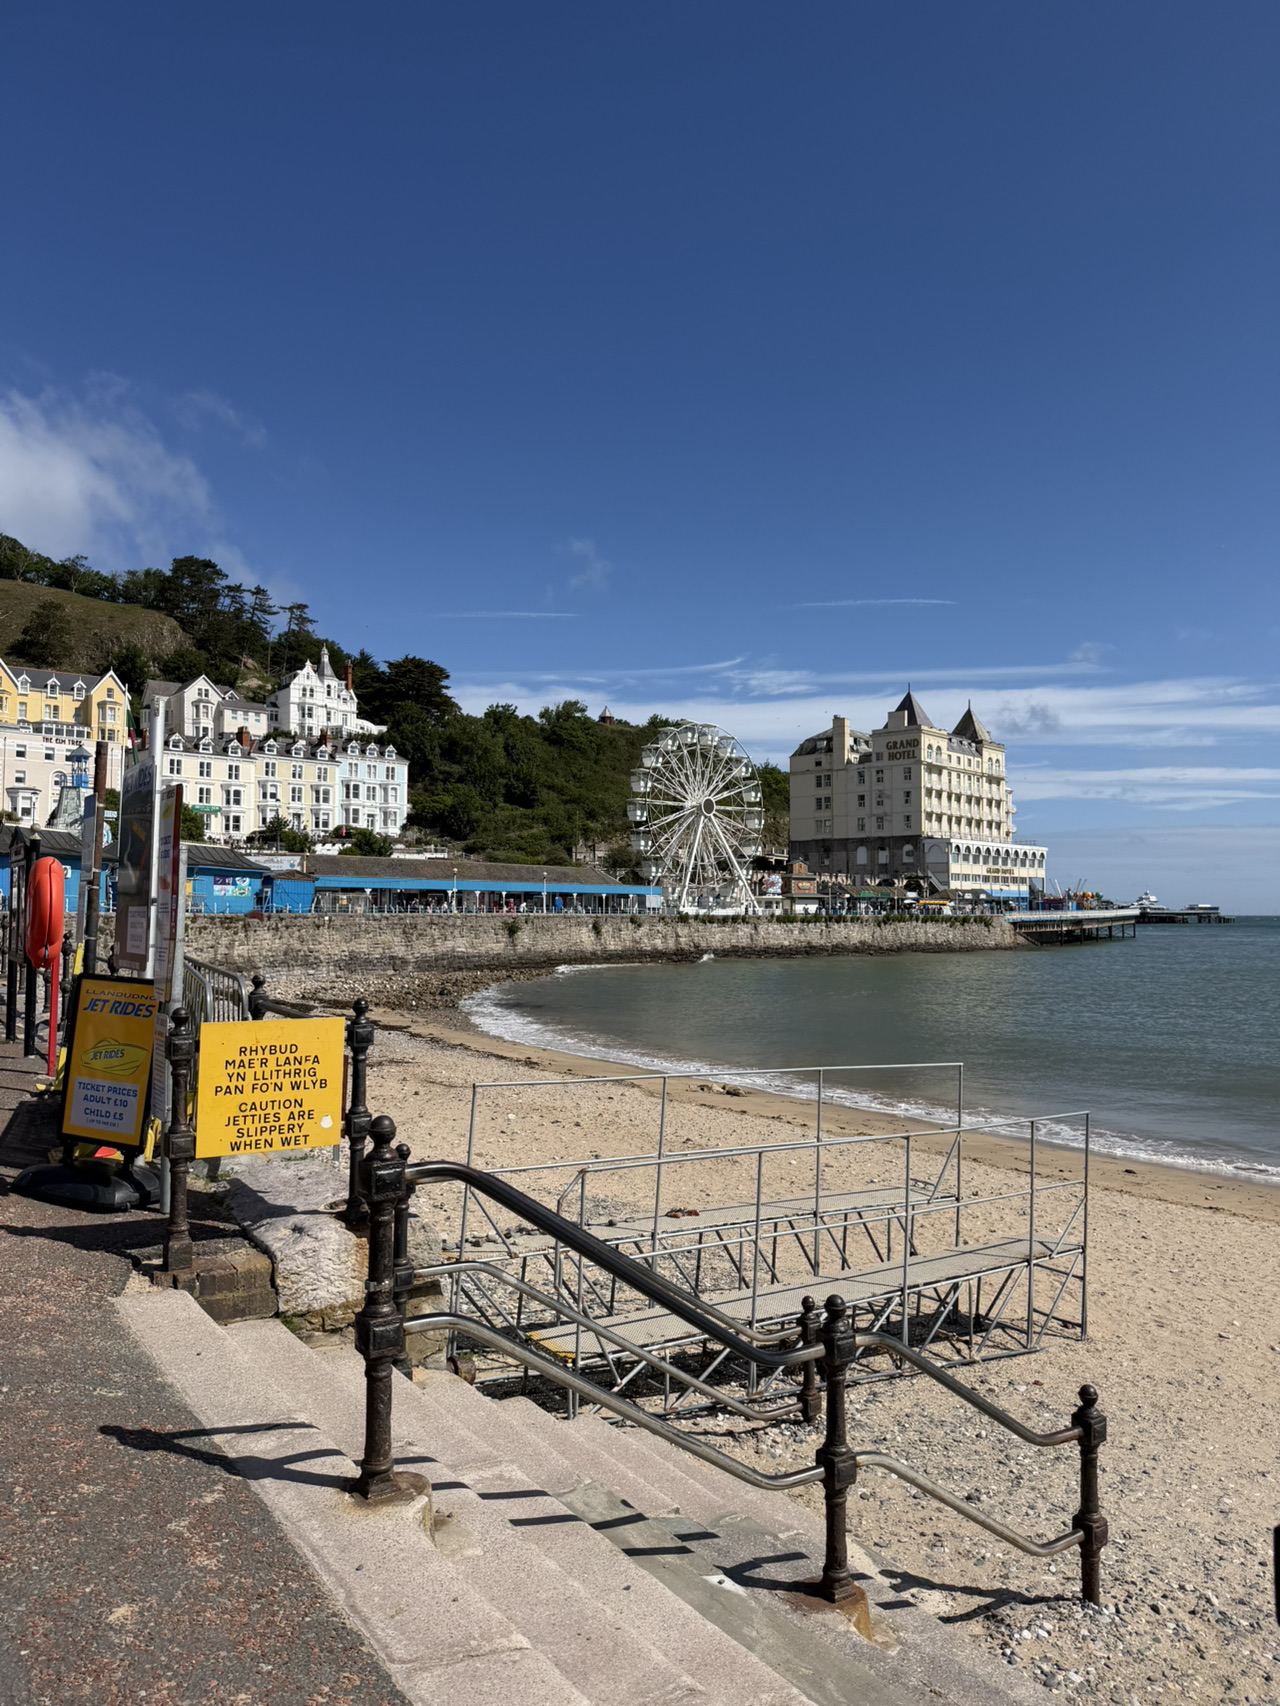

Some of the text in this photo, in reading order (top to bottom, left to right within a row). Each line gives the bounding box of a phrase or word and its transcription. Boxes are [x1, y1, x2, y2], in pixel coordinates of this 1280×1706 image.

[886, 738, 919, 750] GRAND
[888, 749, 917, 761] HOTEL
[82, 998, 156, 1018] JET RIDES
[91, 1049, 125, 1061] JET RIDES
[239, 1044, 298, 1057] RHYBUD
[225, 1055, 320, 1070] MAE'R LANFA
[227, 1067, 317, 1083] YN LLITHRIG
[78, 1081, 138, 1098] TICKET PRICES
[214, 1078, 328, 1096] PAN FO'N WLYB
[83, 1094, 128, 1108] ADULT £10
[238, 1098, 304, 1113] CAUTION
[84, 1107, 124, 1121] CHILD £5
[224, 1109, 315, 1127] JETTIES ARE
[236, 1122, 304, 1138] SLIPPERY
[229, 1134, 310, 1152] WHEN WET
